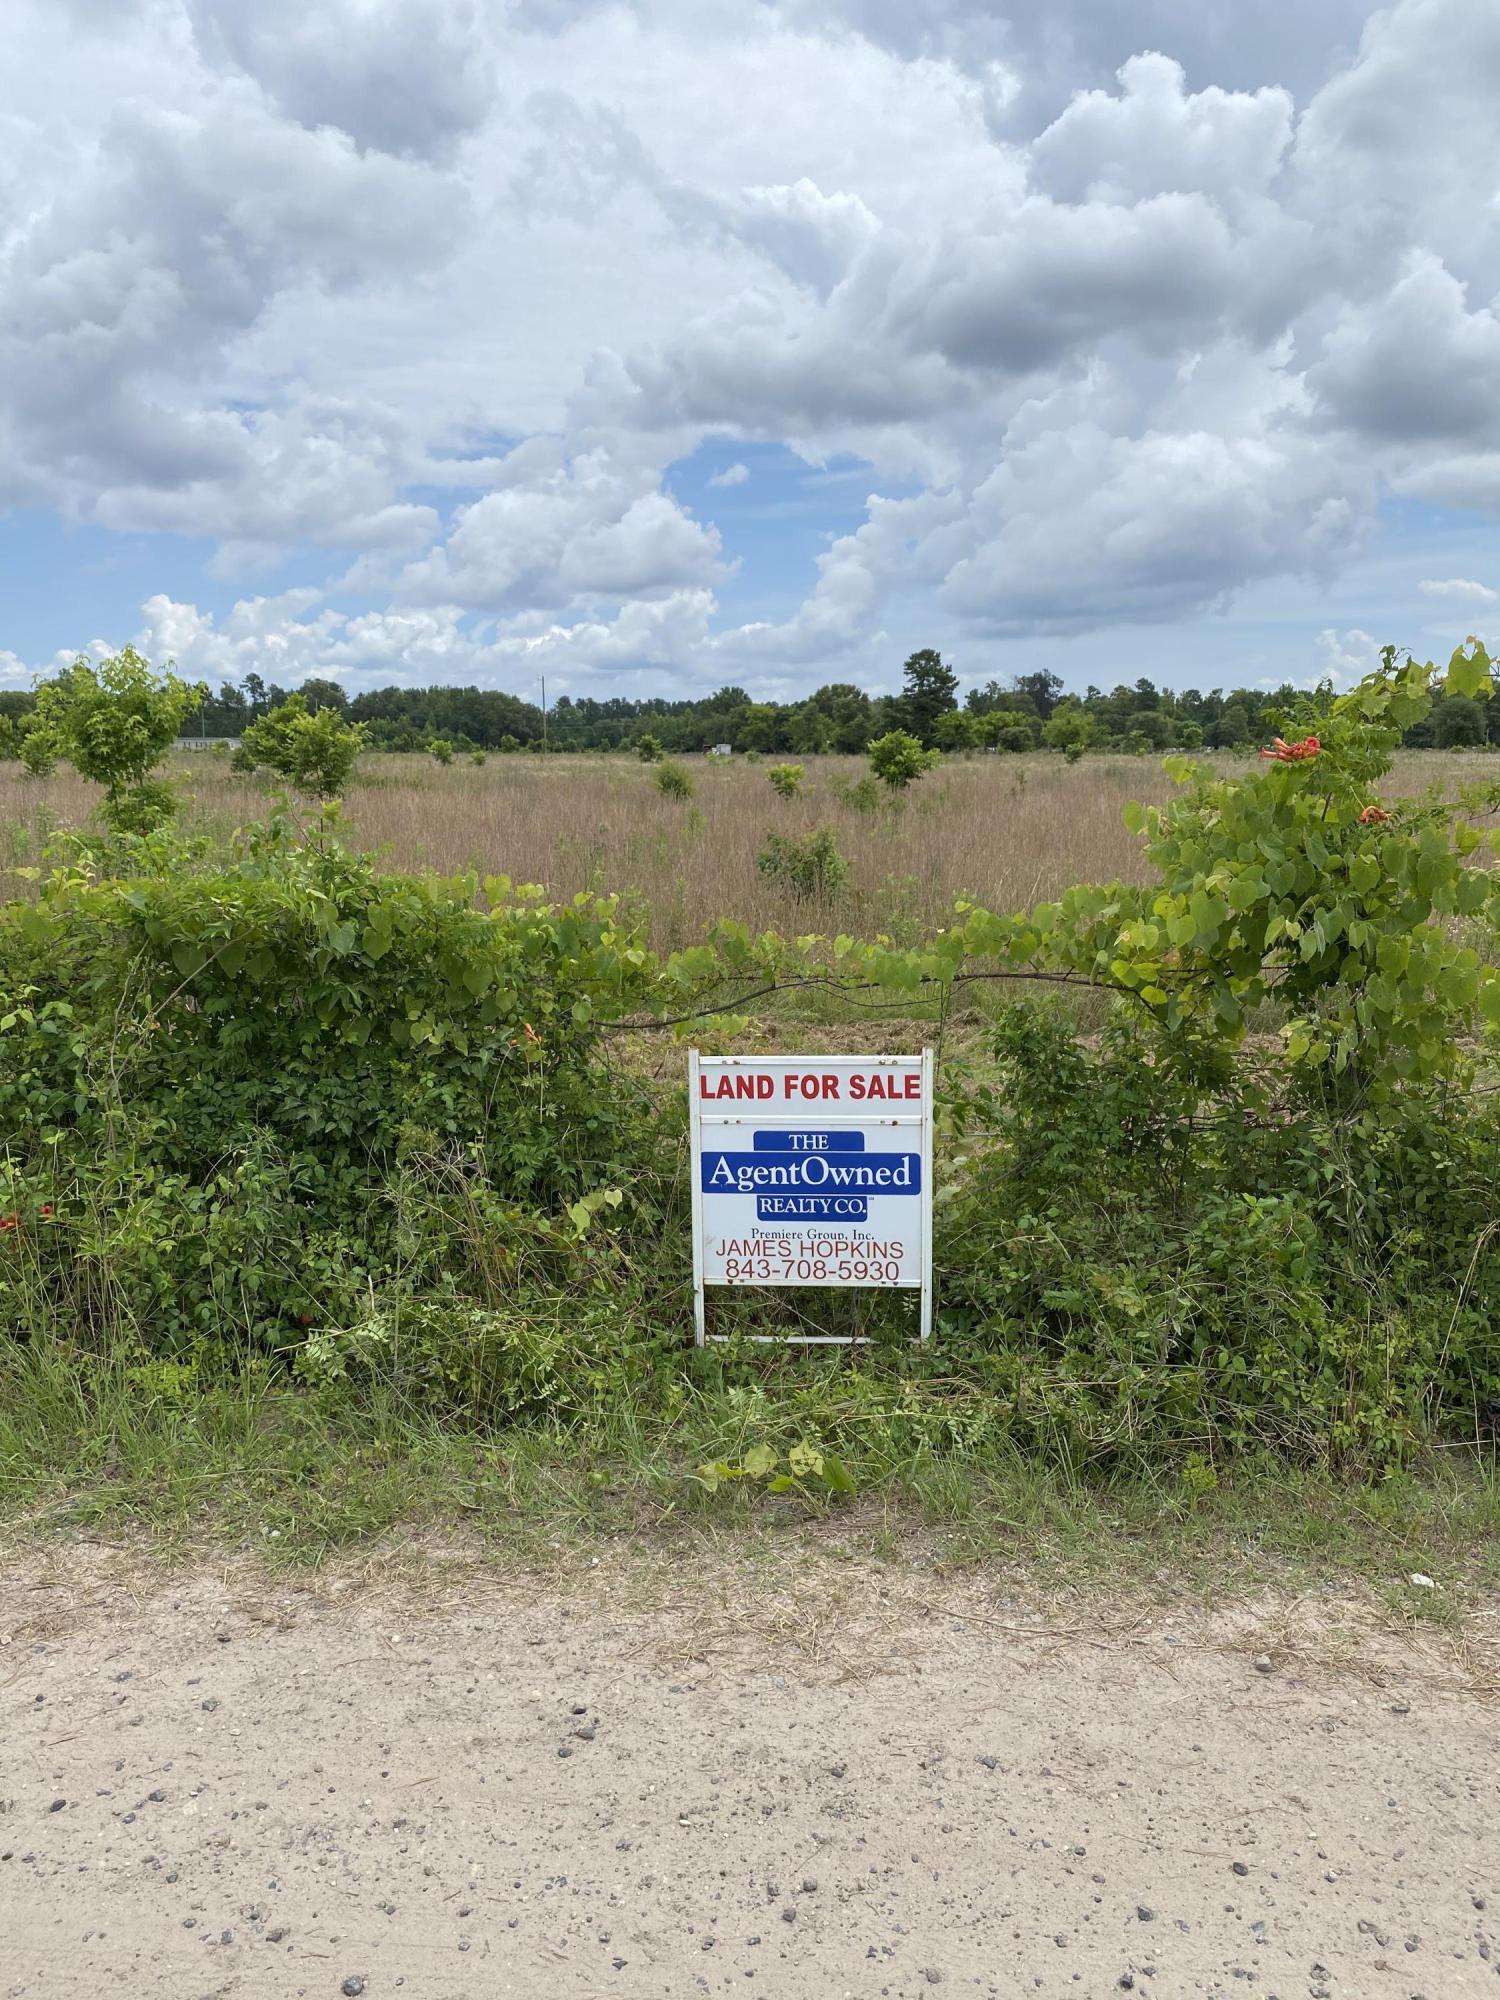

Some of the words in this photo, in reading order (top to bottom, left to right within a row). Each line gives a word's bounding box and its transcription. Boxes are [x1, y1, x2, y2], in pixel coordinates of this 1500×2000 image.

[701, 1075, 774, 1099] LAND
[784, 1075, 840, 1099] FOR
[849, 1075, 920, 1099] SALE
[789, 1134, 829, 1150] THE
[709, 1155, 911, 1191] AgentOwned
[751, 1228, 802, 1239] Premiere
[853, 1229, 874, 1240] Inc.
[716, 1240, 791, 1257] JAMES
[800, 1240, 904, 1259] HOPKINS
[725, 1258, 899, 1280] 843-708-5930
